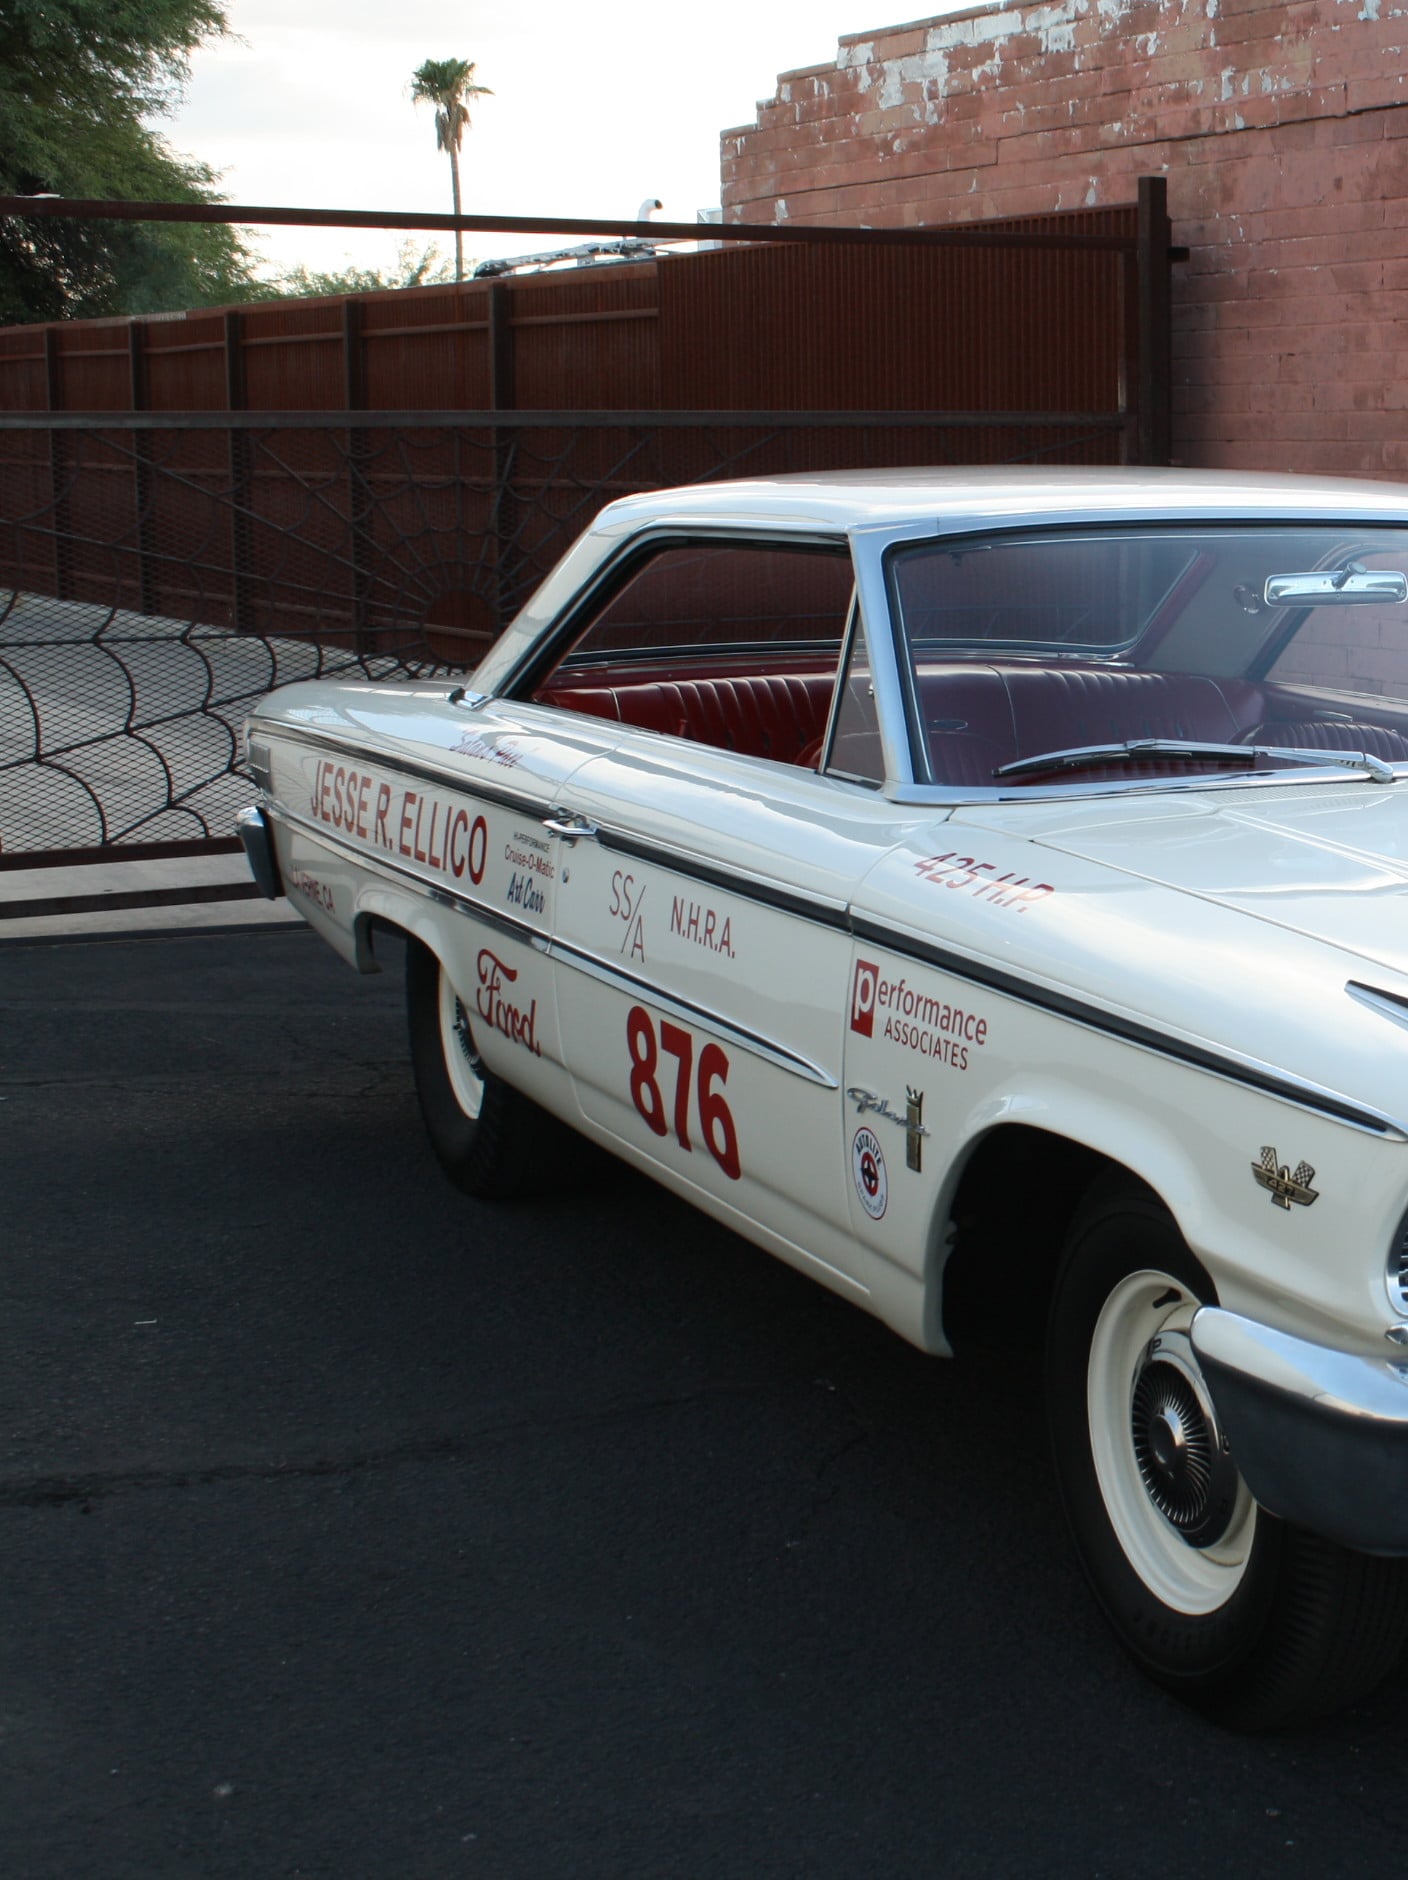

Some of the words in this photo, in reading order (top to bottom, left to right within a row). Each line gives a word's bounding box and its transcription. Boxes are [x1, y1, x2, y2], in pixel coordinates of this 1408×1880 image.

[310, 760, 372, 839] JESSE
[374, 783, 393, 850] R.
[399, 791, 488, 885] ELLICO
[504, 844, 555, 879] Cruise-O-Matic
[913, 852, 997, 889] 425
[972, 872, 1055, 914] H.P.
[670, 895, 735, 959] N.H.R.A.
[884, 1016, 968, 1070] ASSOCIATES
[627, 1006, 741, 1180] 876
